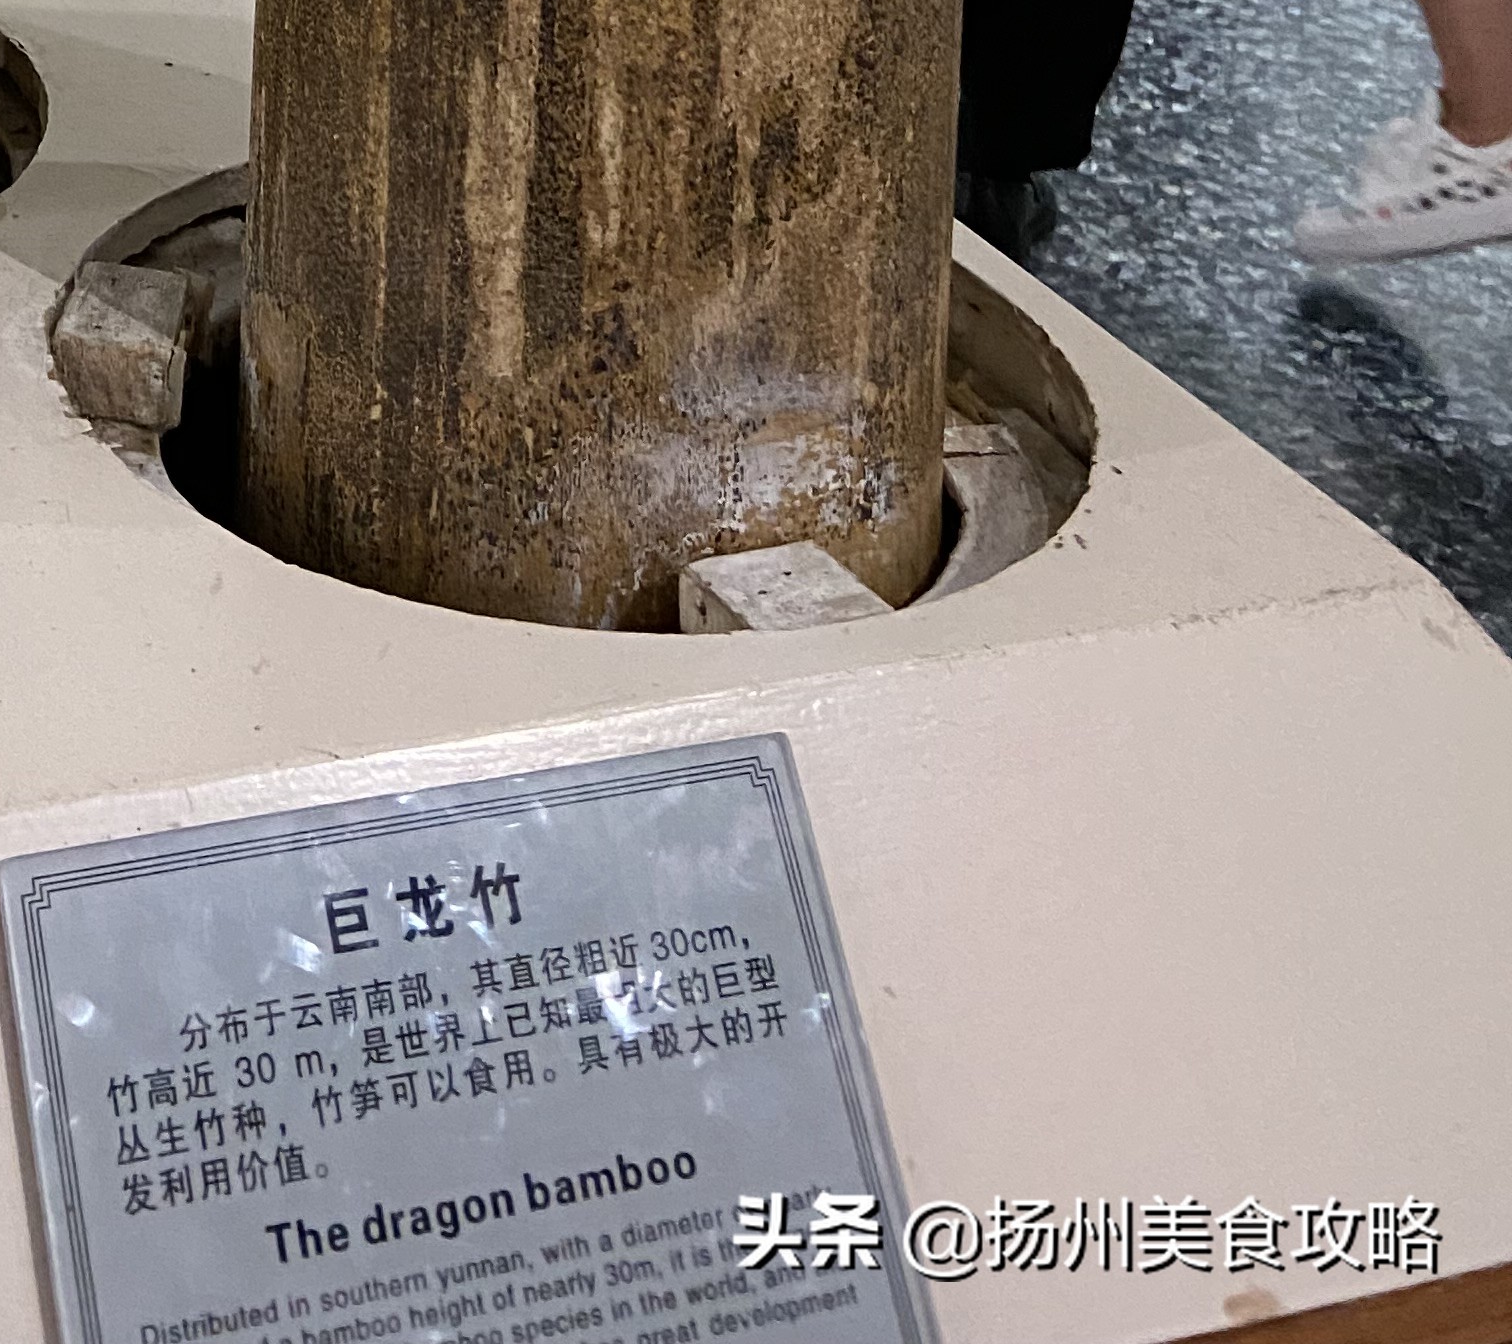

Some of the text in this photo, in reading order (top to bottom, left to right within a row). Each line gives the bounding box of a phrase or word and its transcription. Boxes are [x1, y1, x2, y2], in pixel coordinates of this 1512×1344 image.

[323, 861, 522, 955] 巨龙竹
[121, 1142, 330, 1216] 发利用价值。
[264, 1150, 698, 1264] The dragon bamboo
[140, 1297, 279, 1344] Distributed
[288, 1293, 311, 1320] in
[320, 1269, 429, 1313] southern
[436, 1250, 534, 1294] yunnan,
[539, 1232, 590, 1264] with
[598, 1231, 614, 1253] a
[620, 1206, 724, 1249] diameter
[408, 1289, 487, 1330] height
[492, 1283, 516, 1312] of
[521, 1269, 597, 1304] nearly
[669, 1248, 686, 1273] it
[692, 1243, 714, 1268] is
[511, 1306, 605, 1344] species
[611, 1297, 634, 1322] in
[638, 1289, 678, 1316] the
[686, 1270, 758, 1305] world,
[708, 1282, 859, 1337] development
